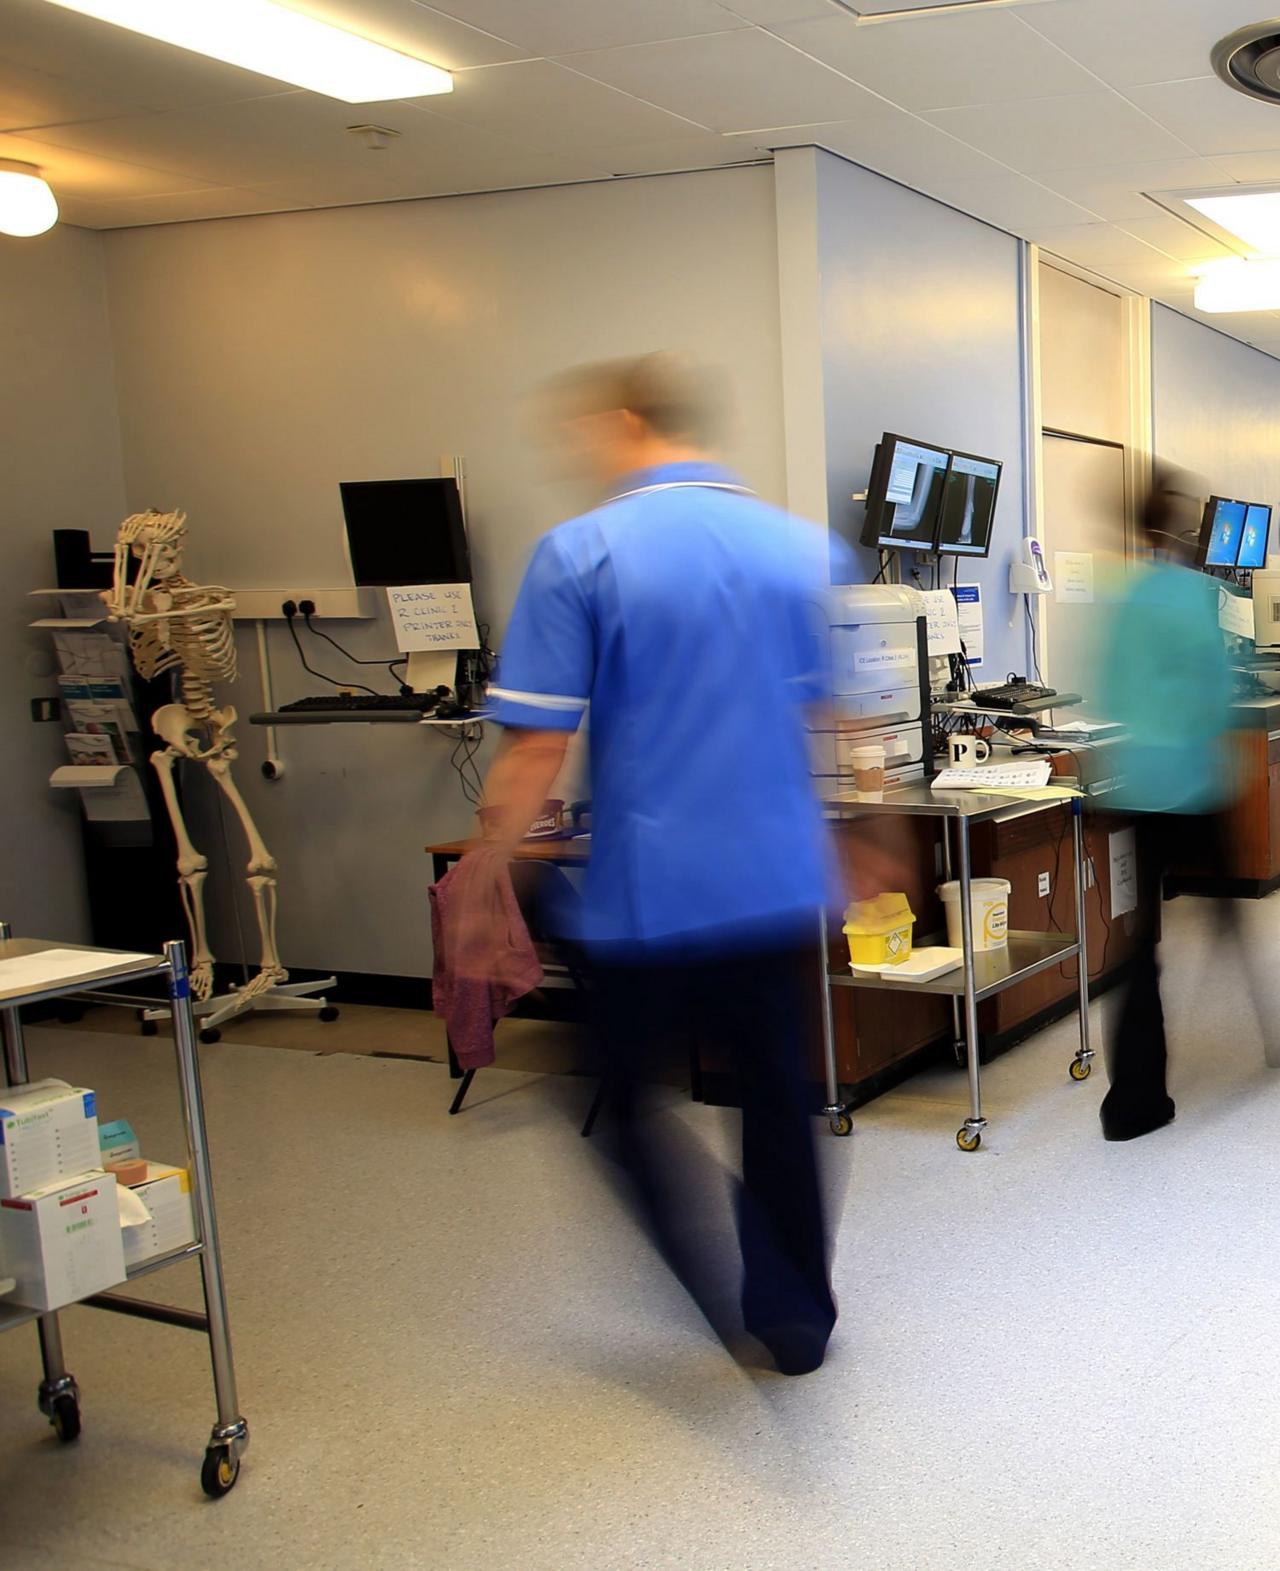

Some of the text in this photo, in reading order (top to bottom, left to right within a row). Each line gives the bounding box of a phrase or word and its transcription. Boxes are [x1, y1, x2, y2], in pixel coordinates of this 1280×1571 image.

[393, 591, 462, 603] PLEASE USE
[403, 620, 453, 631] PRINTER
[953, 743, 968, 762] P
